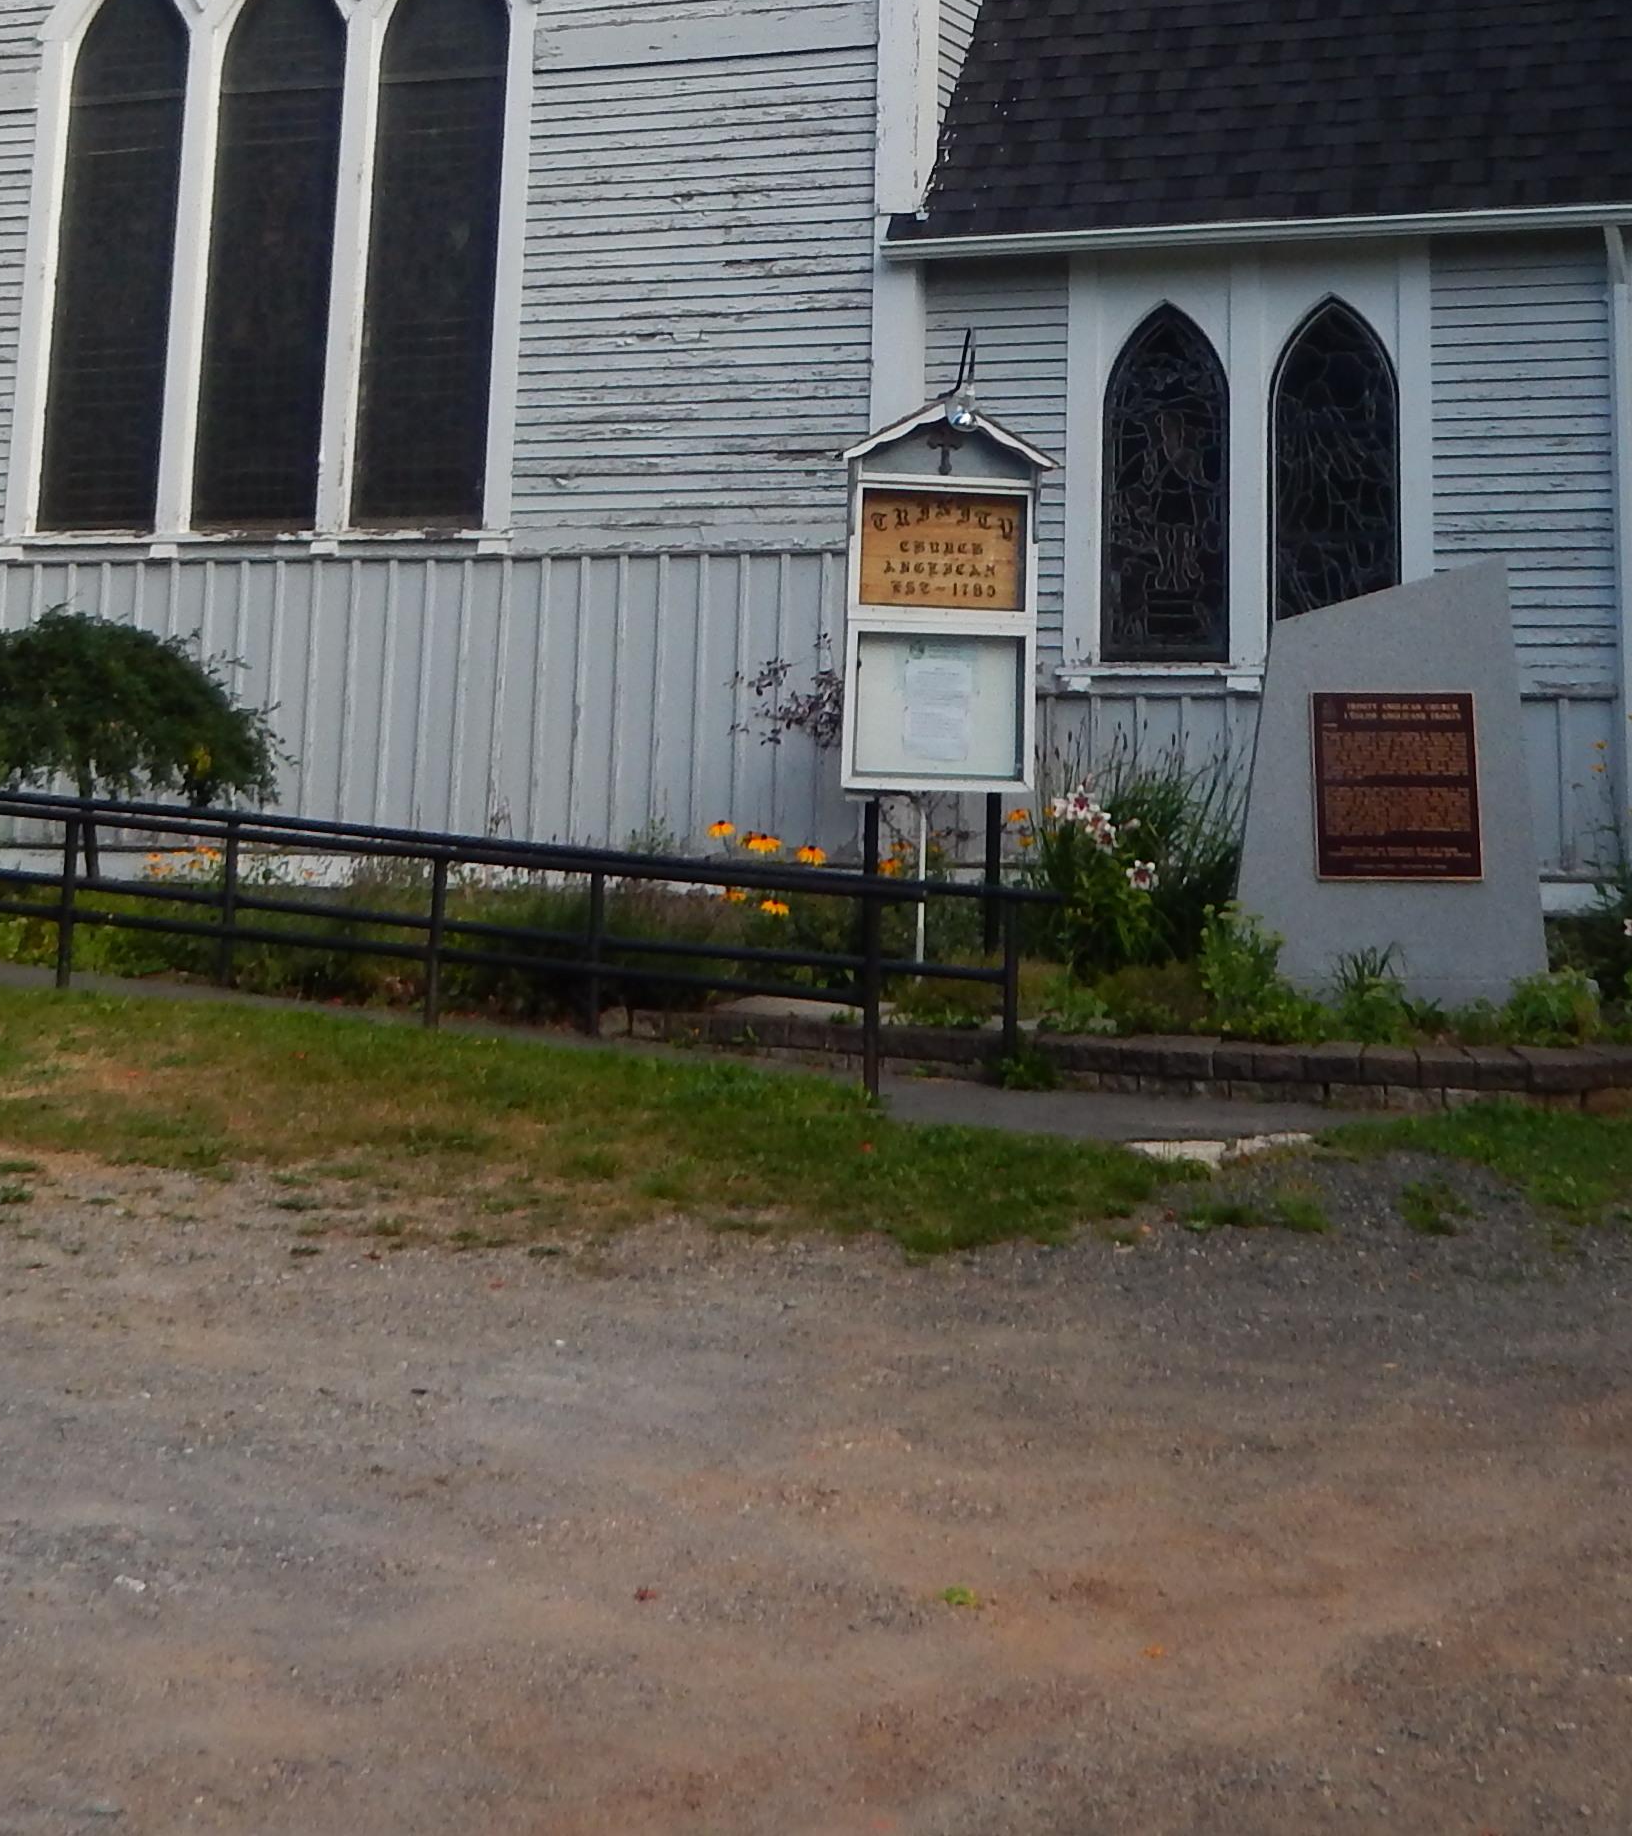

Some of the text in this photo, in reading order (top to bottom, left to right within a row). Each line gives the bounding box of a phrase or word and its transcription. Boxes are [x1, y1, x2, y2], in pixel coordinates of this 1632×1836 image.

[870, 500, 1014, 542] TRINITY
[899, 540, 984, 555] CHURCH
[883, 560, 996, 578] ANGLICAN
